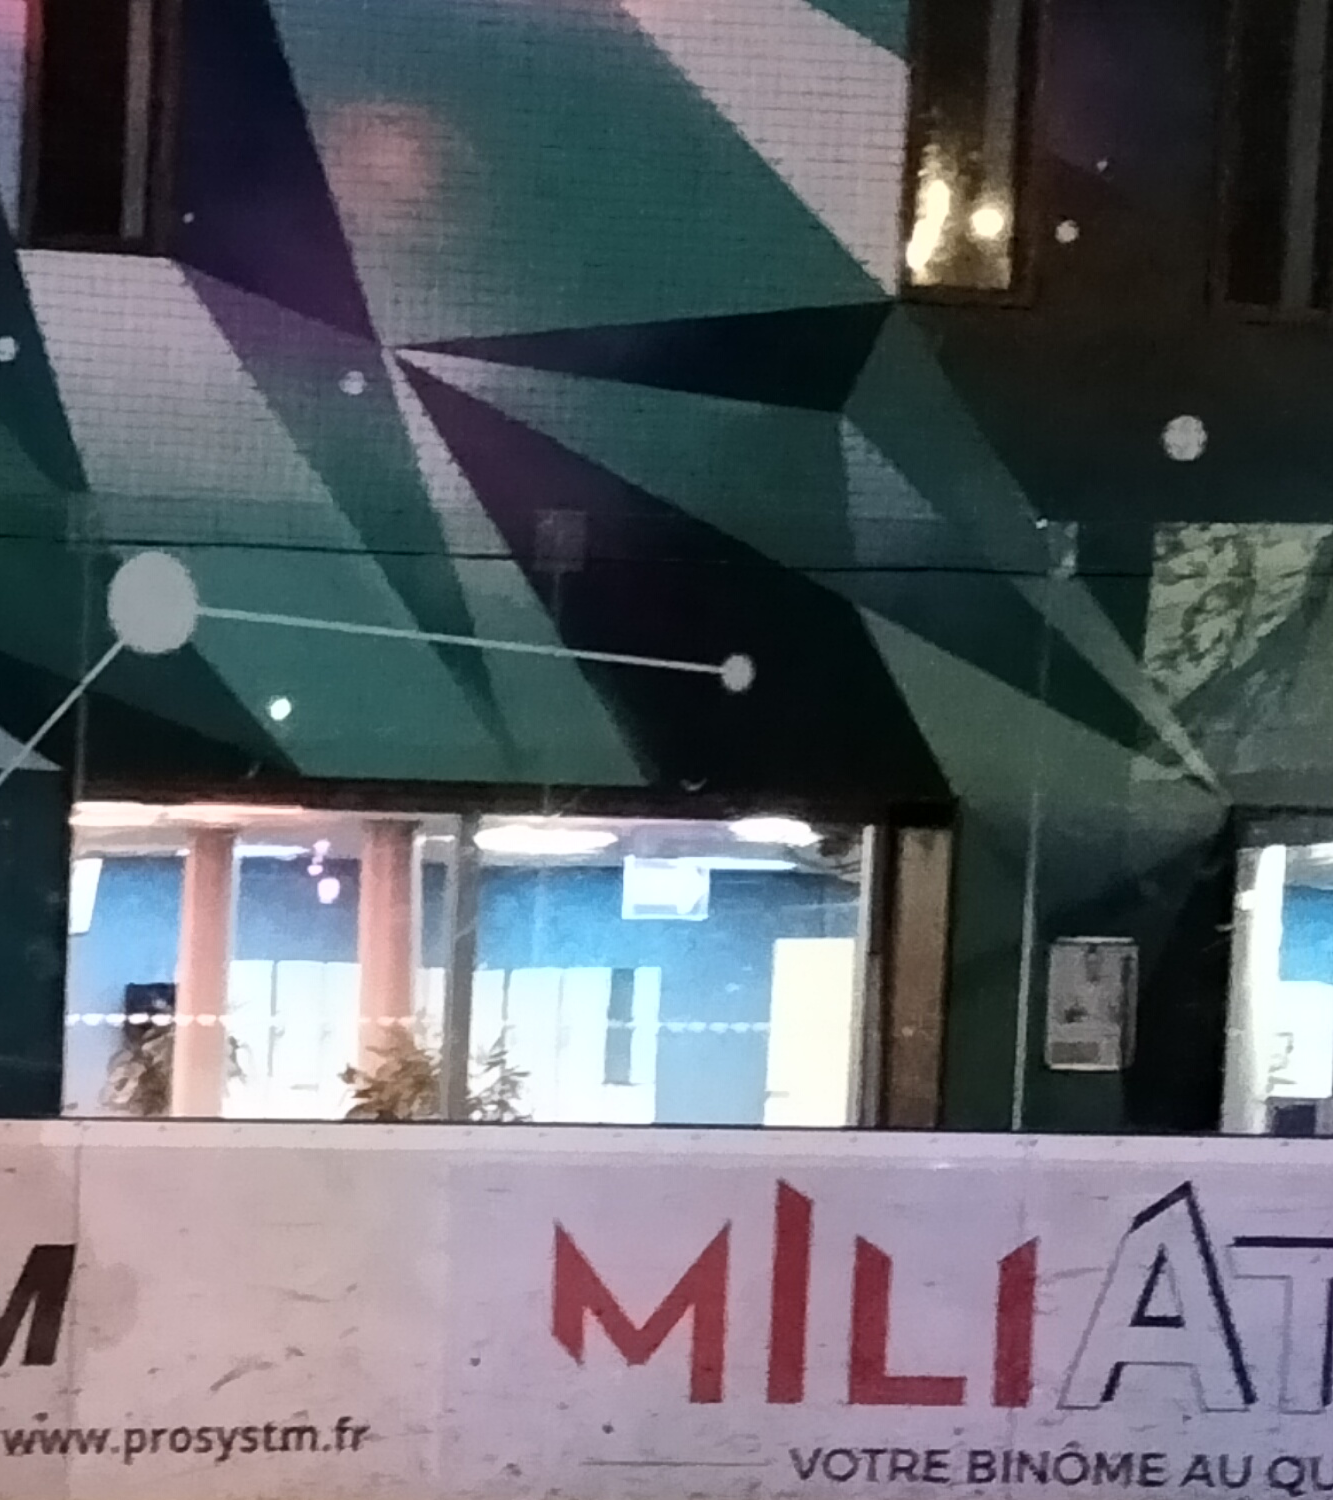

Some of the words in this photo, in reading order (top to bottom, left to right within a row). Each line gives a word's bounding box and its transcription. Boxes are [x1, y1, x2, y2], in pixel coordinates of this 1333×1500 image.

[0, 1416, 371, 1465] www.prosystm.fr
[792, 1448, 947, 1482] VOTRE
[970, 1442, 1166, 1487] BINÔME
[1179, 1454, 1254, 1488] AU
